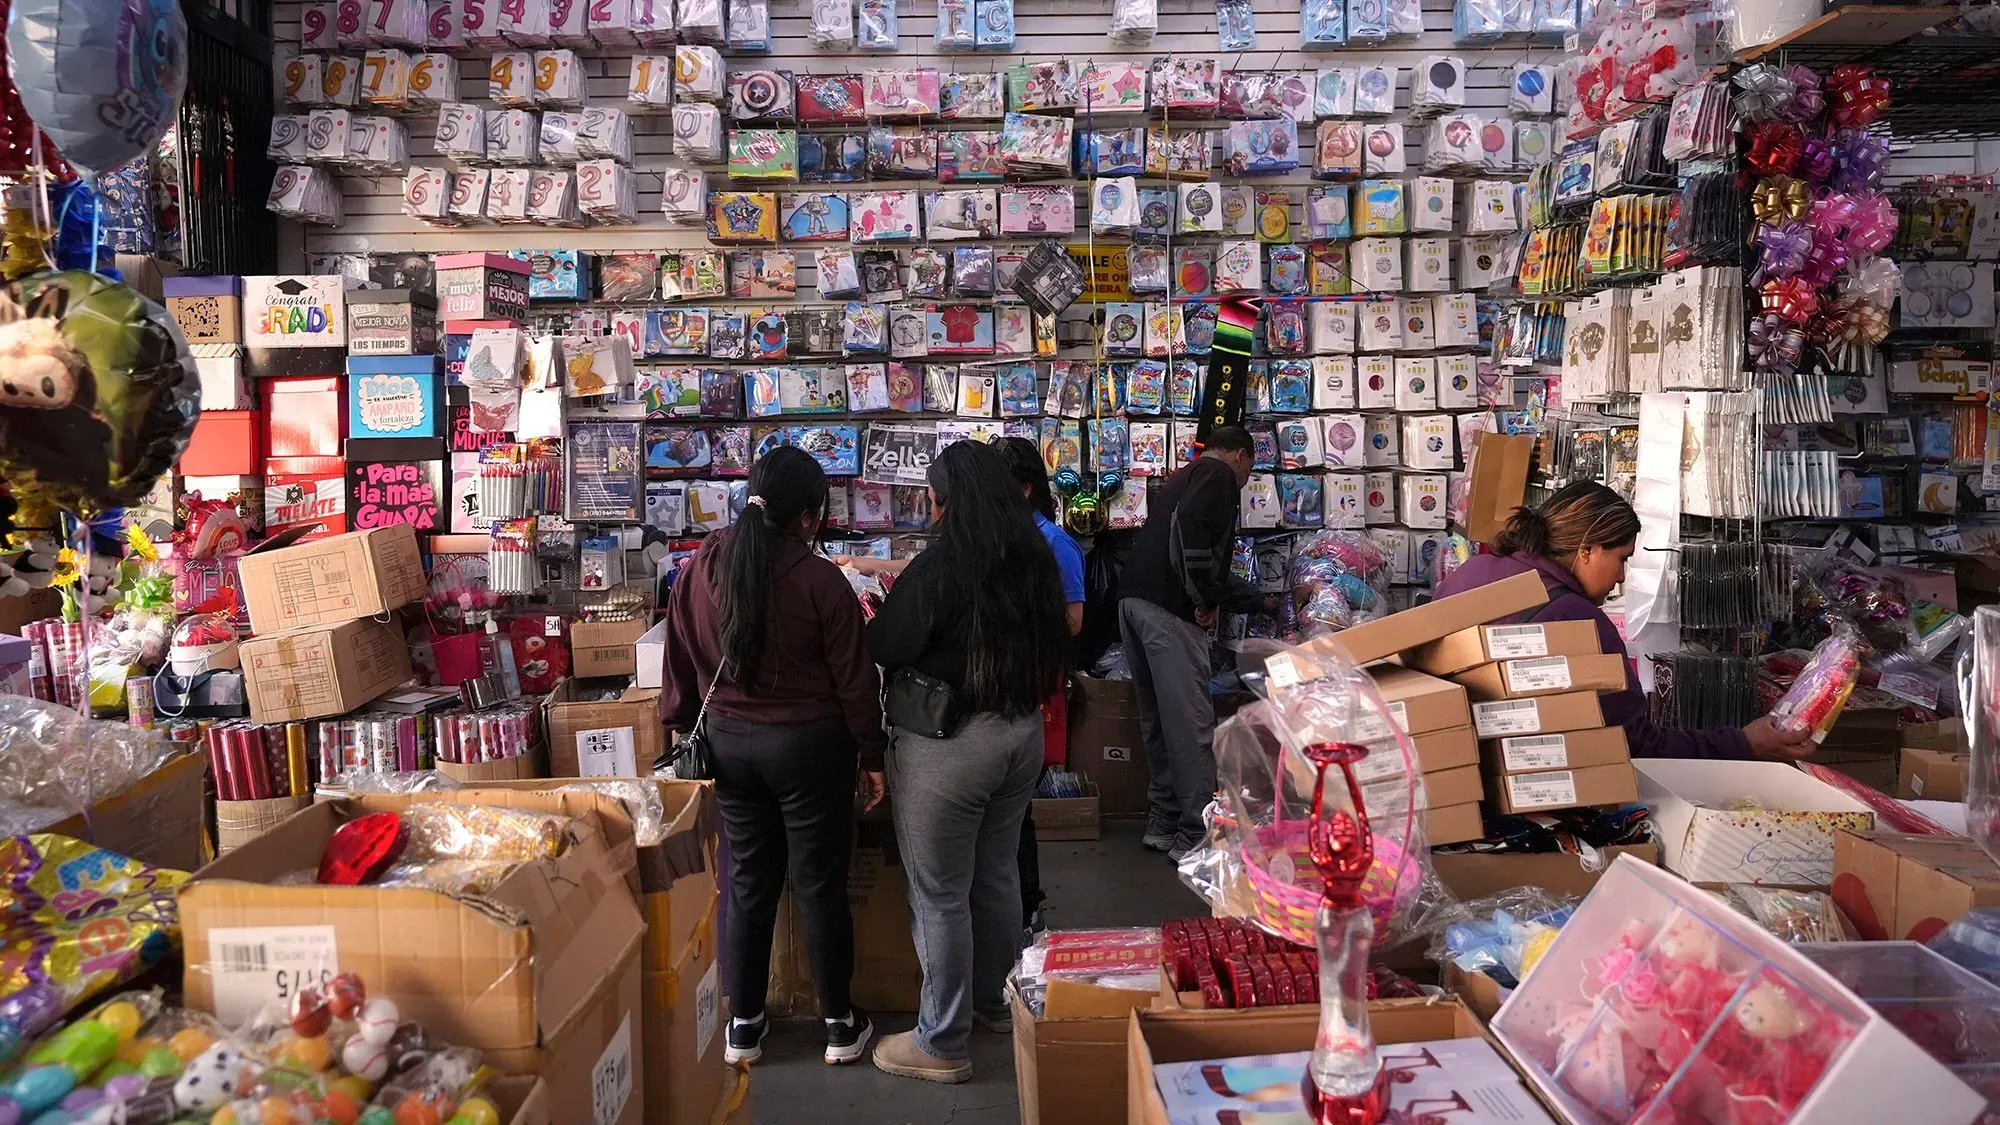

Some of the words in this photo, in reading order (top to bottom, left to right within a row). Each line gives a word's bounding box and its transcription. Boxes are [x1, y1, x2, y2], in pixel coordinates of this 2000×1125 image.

[366, 57, 387, 90] 7
[410, 59, 433, 90] 6
[489, 57, 513, 90] 4
[535, 57, 558, 91] 3
[307, 116, 333, 150] 8
[437, 109, 464, 141] 5
[577, 110, 605, 138] 2
[406, 173, 430, 205] 6
[453, 173, 477, 205] 5
[579, 165, 601, 200] 2
[450, 281, 475, 297] muy
[489, 284, 525, 307] MEJOR
[265, 294, 318, 310] Congrats
[446, 297, 477, 314] feliz
[488, 301, 526, 321] NOVIO
[252, 303, 335, 335] GRAD!
[355, 316, 382, 328] MEJOR
[383, 316, 408, 328] NOVIA
[353, 341, 370, 350] LOS
[371, 340, 406, 349] TIEMPOS
[366, 379, 414, 396] Dios
[369, 402, 415, 417] AMPARO
[379, 414, 415, 425] fortaleza
[867, 441, 931, 470] Zelle
[267, 475, 277, 486] 12
[367, 463, 418, 484] Para
[360, 480, 381, 504] la
[386, 478, 434, 506] más
[219, 538, 239, 549] LOVE
[546, 619, 561, 631] SH
[1108, 748, 1126, 760] Q
